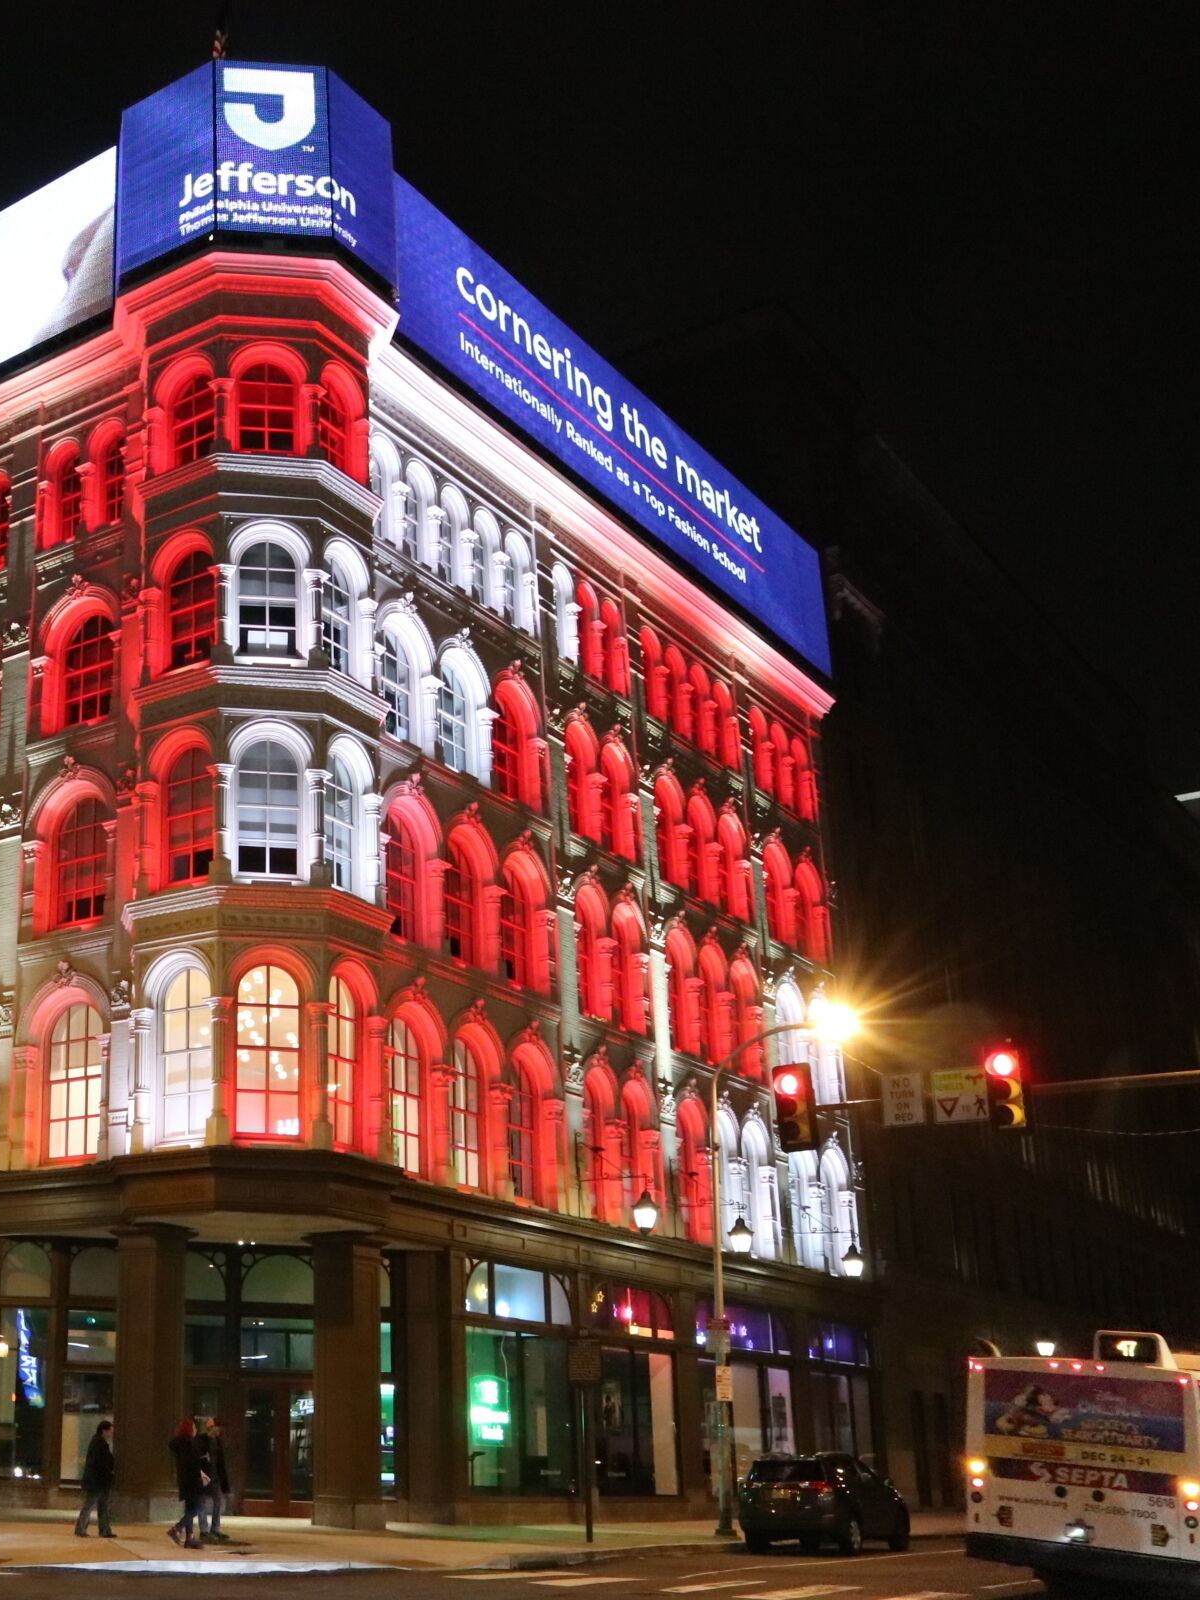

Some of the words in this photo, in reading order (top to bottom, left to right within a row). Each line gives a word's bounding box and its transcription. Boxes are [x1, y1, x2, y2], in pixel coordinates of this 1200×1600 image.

[179, 161, 357, 218] Jefferson
[179, 199, 259, 223] Philadelphia
[261, 200, 333, 217] University
[179, 212, 229, 237] Thomas
[231, 212, 297, 227] Jefferson
[299, 216, 358, 247] University
[456, 266, 615, 432] cornering
[620, 401, 668, 470] the
[675, 455, 763, 554] market
[459, 331, 562, 433] Internationally
[566, 421, 613, 473] Ranked
[616, 466, 630, 486] as
[633, 480, 641, 496] a
[642, 484, 665, 517] Top
[668, 504, 711, 554] Fashion
[712, 547, 747, 584] School
[892, 1077, 911, 1089] NO
[890, 1090, 915, 1100] TURN
[896, 1102, 910, 1111] ON
[894, 1113, 914, 1122] RED
[1119, 1431, 1160, 1448] PARTY
[1081, 1451, 1107, 1462] DEC
[1055, 1467, 1128, 1489] SEPTA
